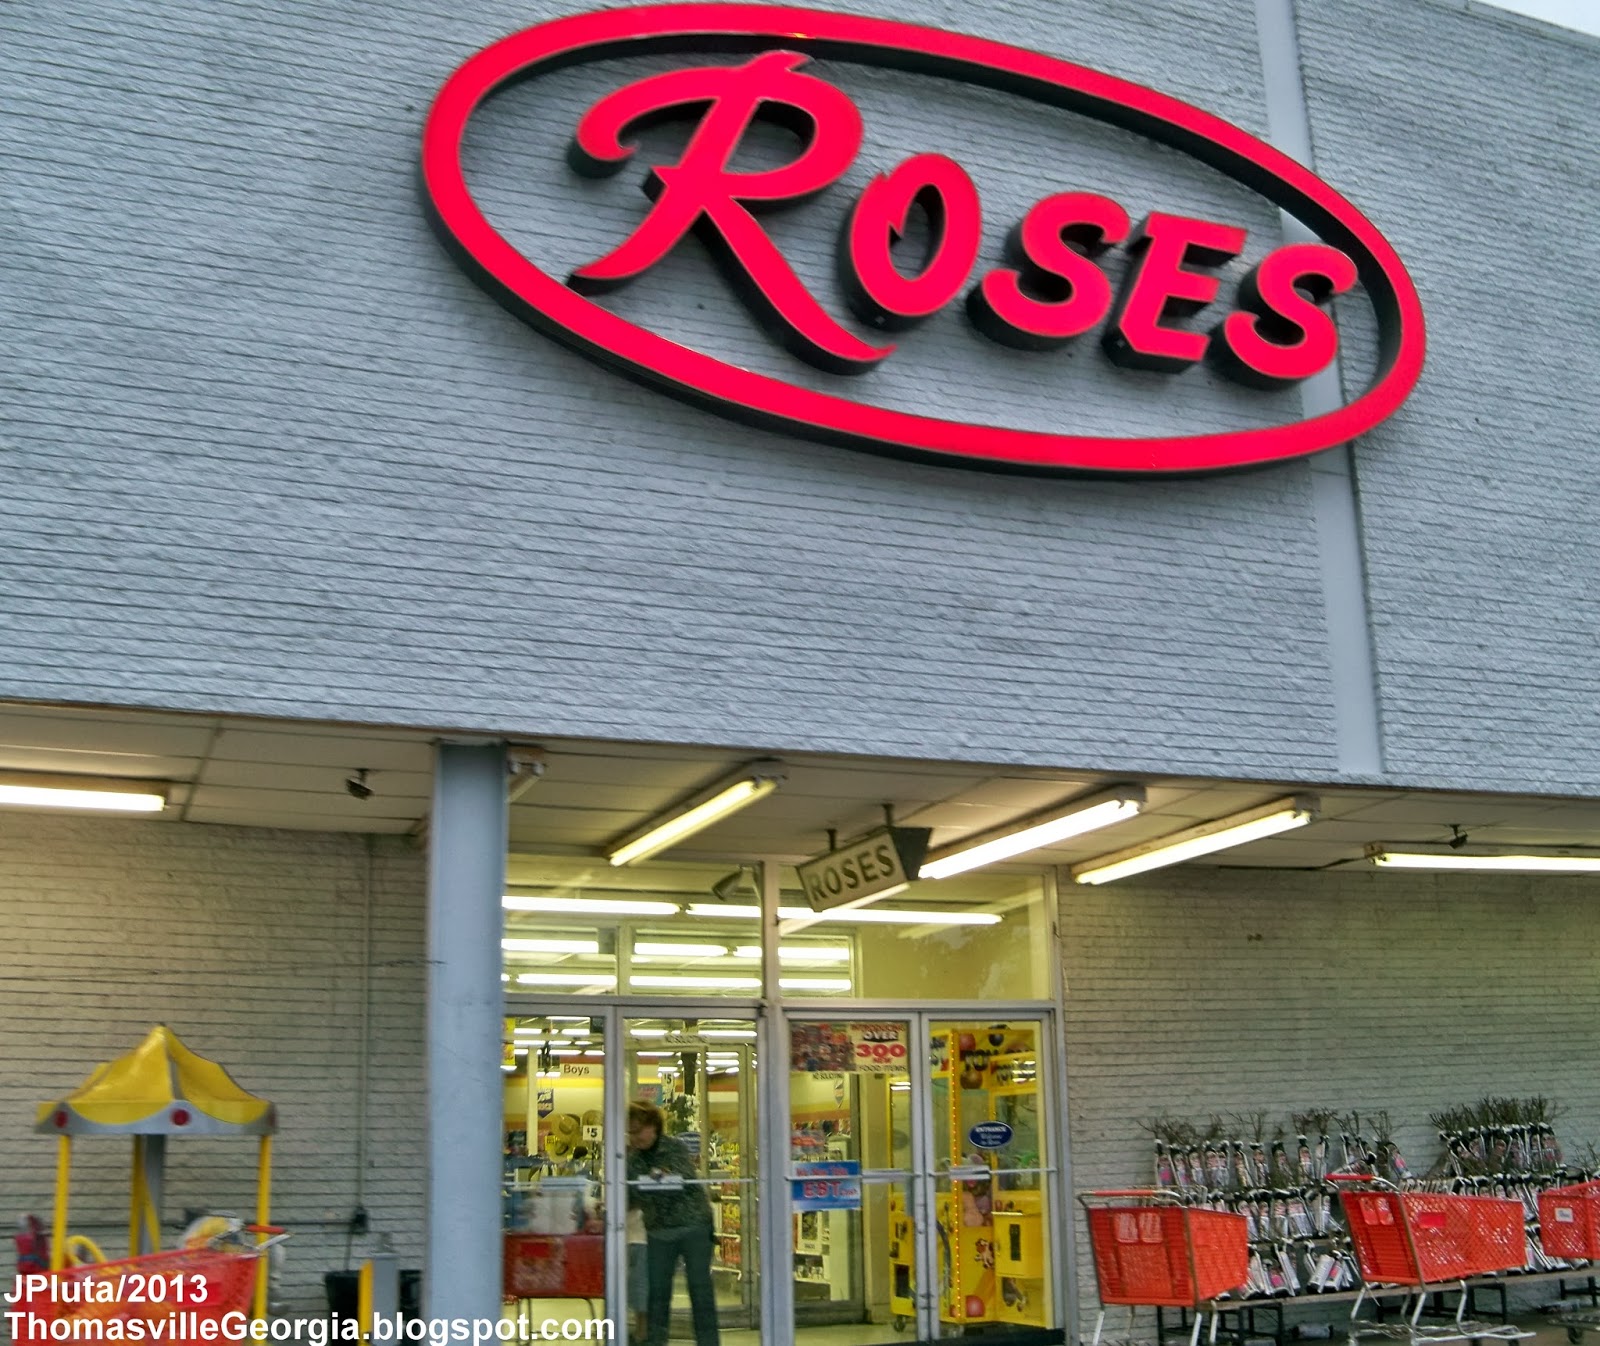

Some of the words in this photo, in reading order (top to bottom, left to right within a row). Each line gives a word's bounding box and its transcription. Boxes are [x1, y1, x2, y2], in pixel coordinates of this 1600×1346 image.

[569, 50, 1359, 383] ROSES
[807, 844, 896, 901] ROSES
[863, 1031, 899, 1040] OVER
[856, 1043, 906, 1057] 300
[563, 1064, 590, 1076] Boys
[586, 1127, 598, 1138] $5
